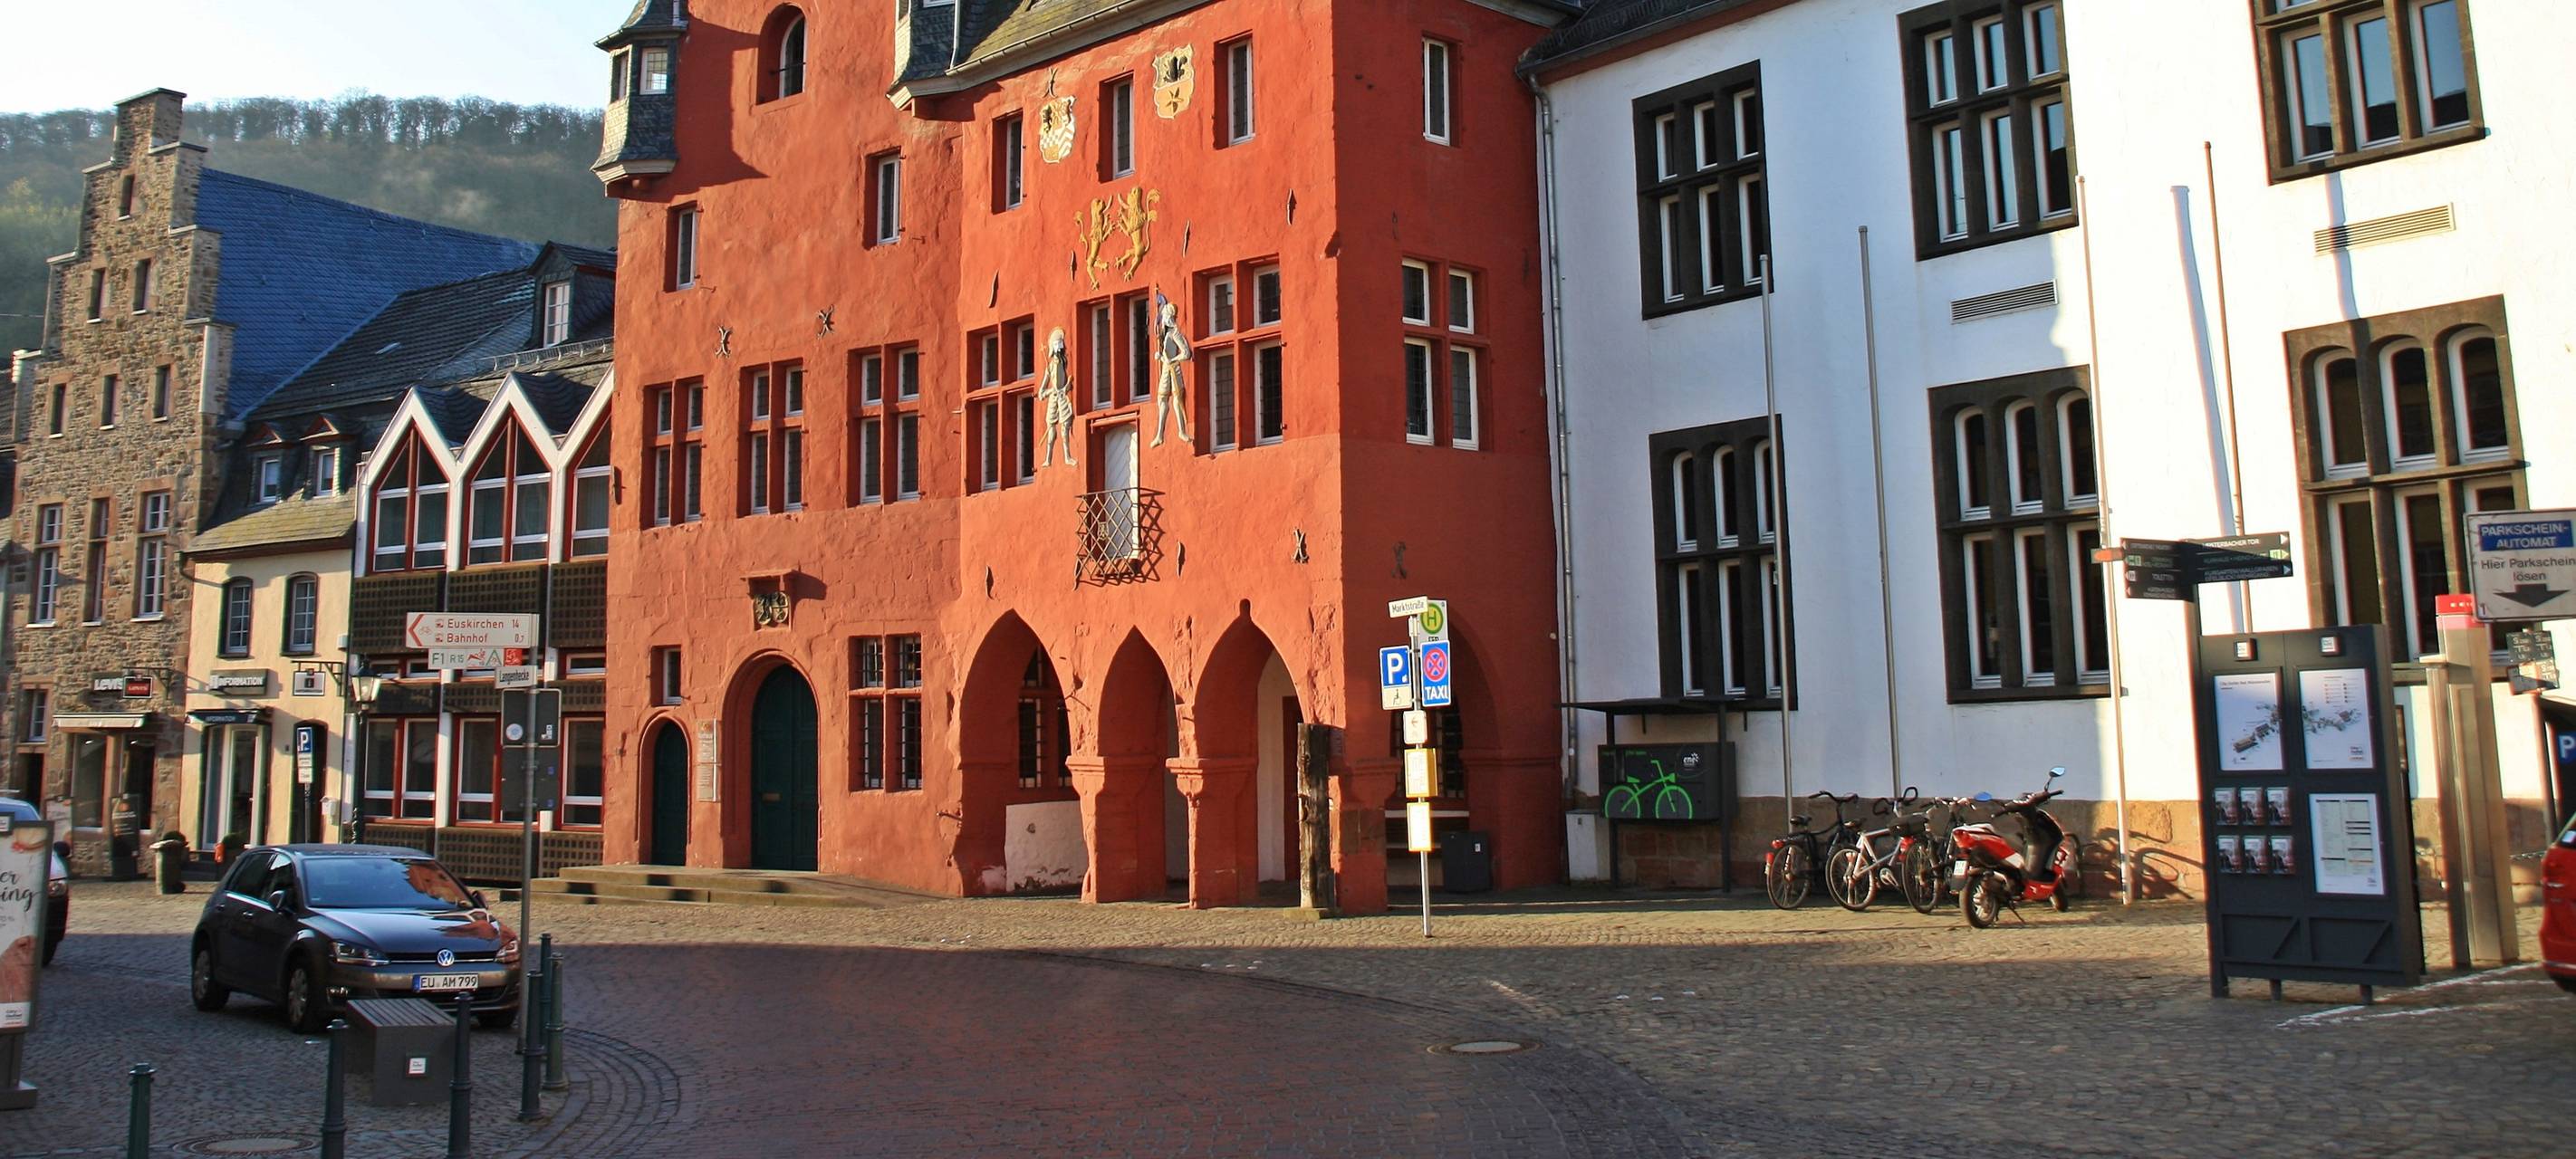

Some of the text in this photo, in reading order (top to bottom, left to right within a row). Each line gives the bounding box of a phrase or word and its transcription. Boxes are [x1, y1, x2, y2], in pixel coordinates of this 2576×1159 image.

[2481, 522, 2569, 536] PARKSCHEIN-
[2496, 537, 2557, 548] AUTOMAT
[2481, 557, 2576, 570] Hier Parkschein
[2514, 572, 2546, 581] lösen
[1392, 600, 1425, 613] Marktstraße
[447, 618, 519, 628] Euskirchen 14
[447, 633, 488, 643] Bahnhof
[432, 653, 445, 665] F1
[1387, 653, 1403, 685] P
[499, 670, 530, 685] Langenhecke
[1425, 685, 1448, 700] TAXI
[300, 732, 309, 752] P
[2558, 735, 2575, 759] P
[420, 977, 477, 988] EU AM 799
